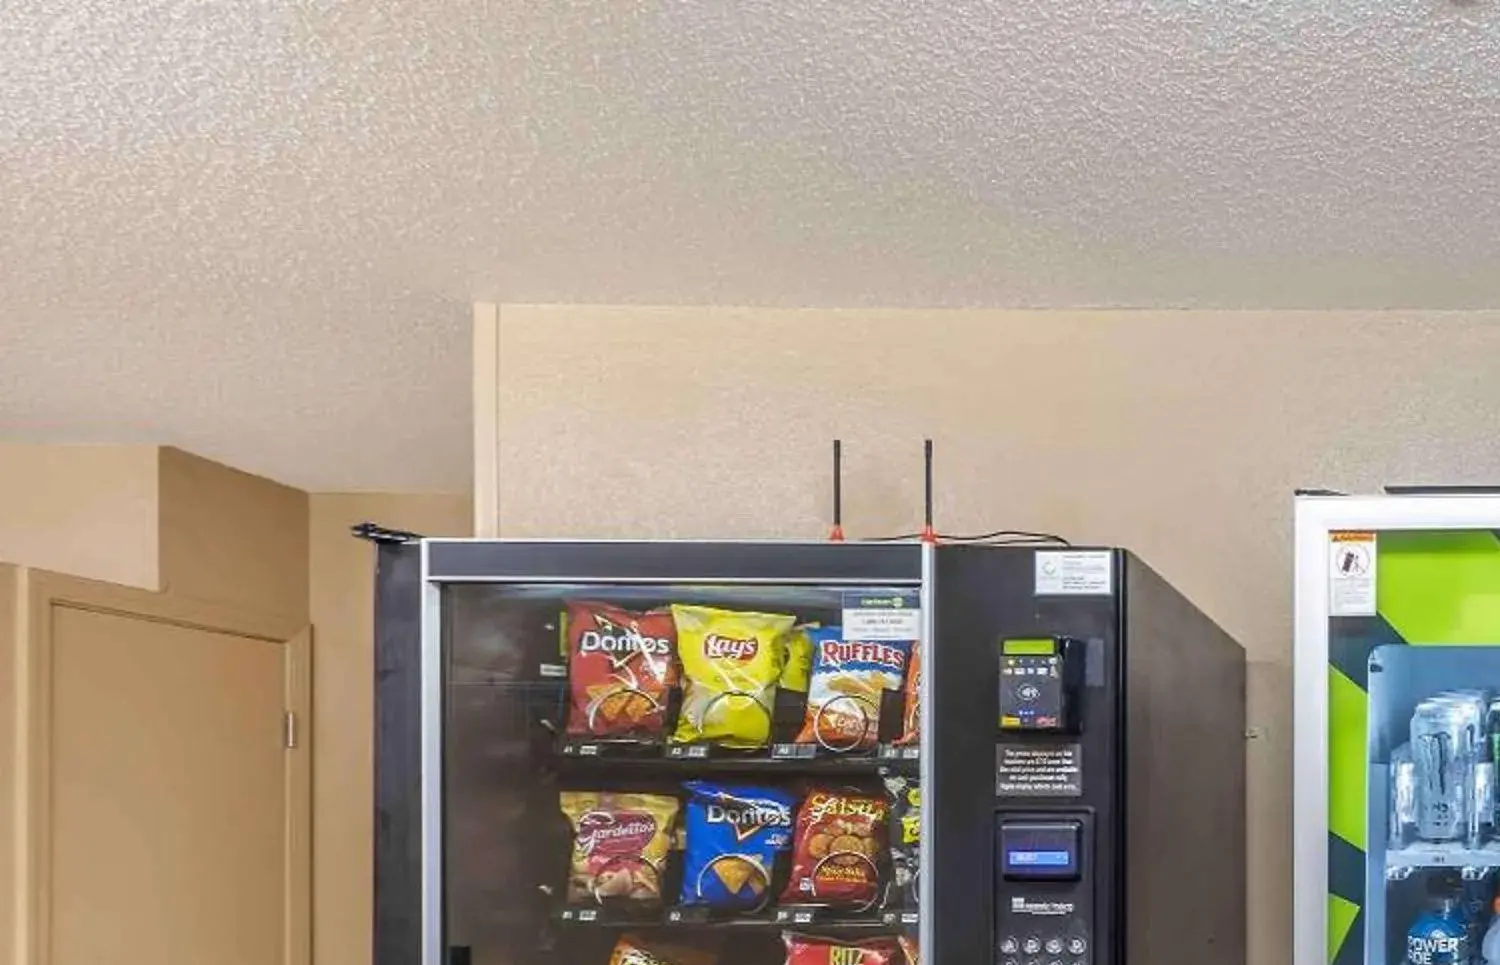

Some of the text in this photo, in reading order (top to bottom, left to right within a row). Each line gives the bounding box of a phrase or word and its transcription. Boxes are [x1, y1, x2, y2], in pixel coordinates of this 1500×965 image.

[580, 630, 670, 655] Doritos
[820, 640, 906, 667] RUFFLES
[706, 804, 792, 827] Doritos
[828, 944, 866, 965] RITZ
